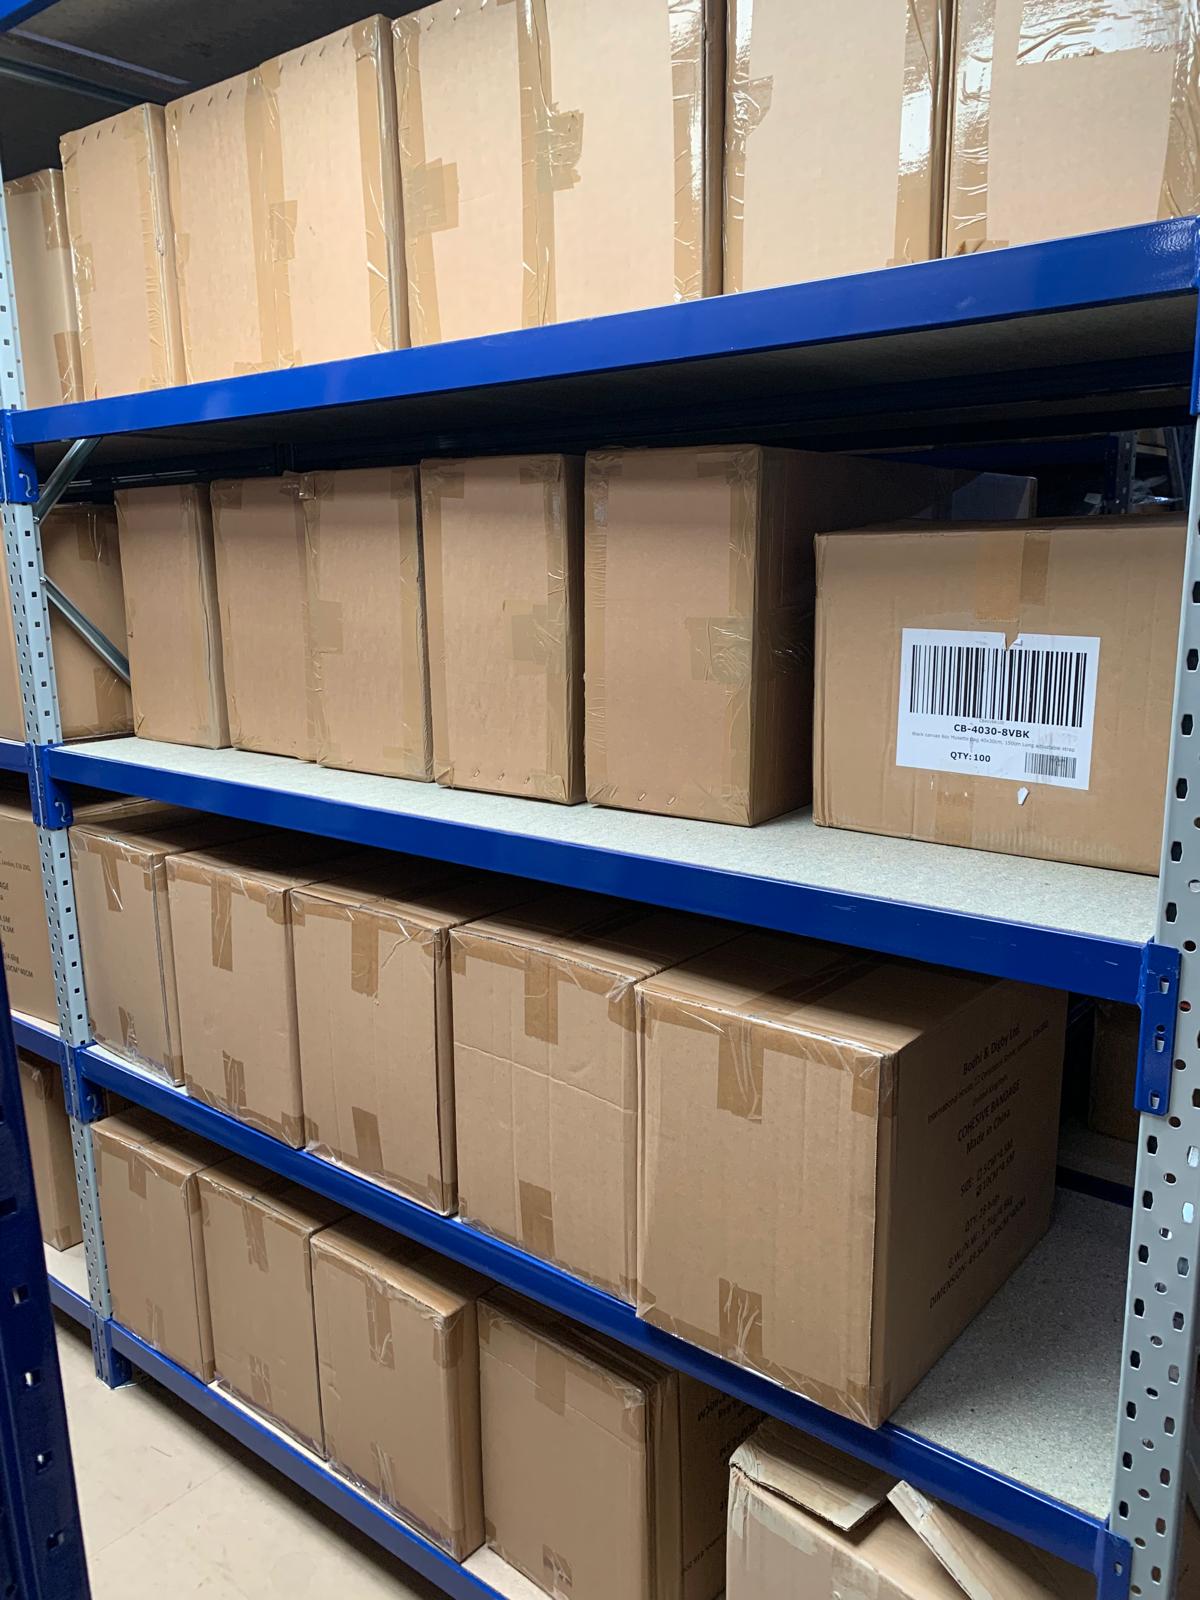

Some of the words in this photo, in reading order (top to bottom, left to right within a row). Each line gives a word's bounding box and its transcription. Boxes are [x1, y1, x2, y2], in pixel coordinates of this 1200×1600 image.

[953, 723, 1030, 739] CB-4030-8VBK
[957, 1103, 991, 1142] COHESIVE
[990, 1079, 1021, 1114] BANDAGE
[966, 1132, 985, 1155] Made
[993, 1108, 1011, 1130] China
